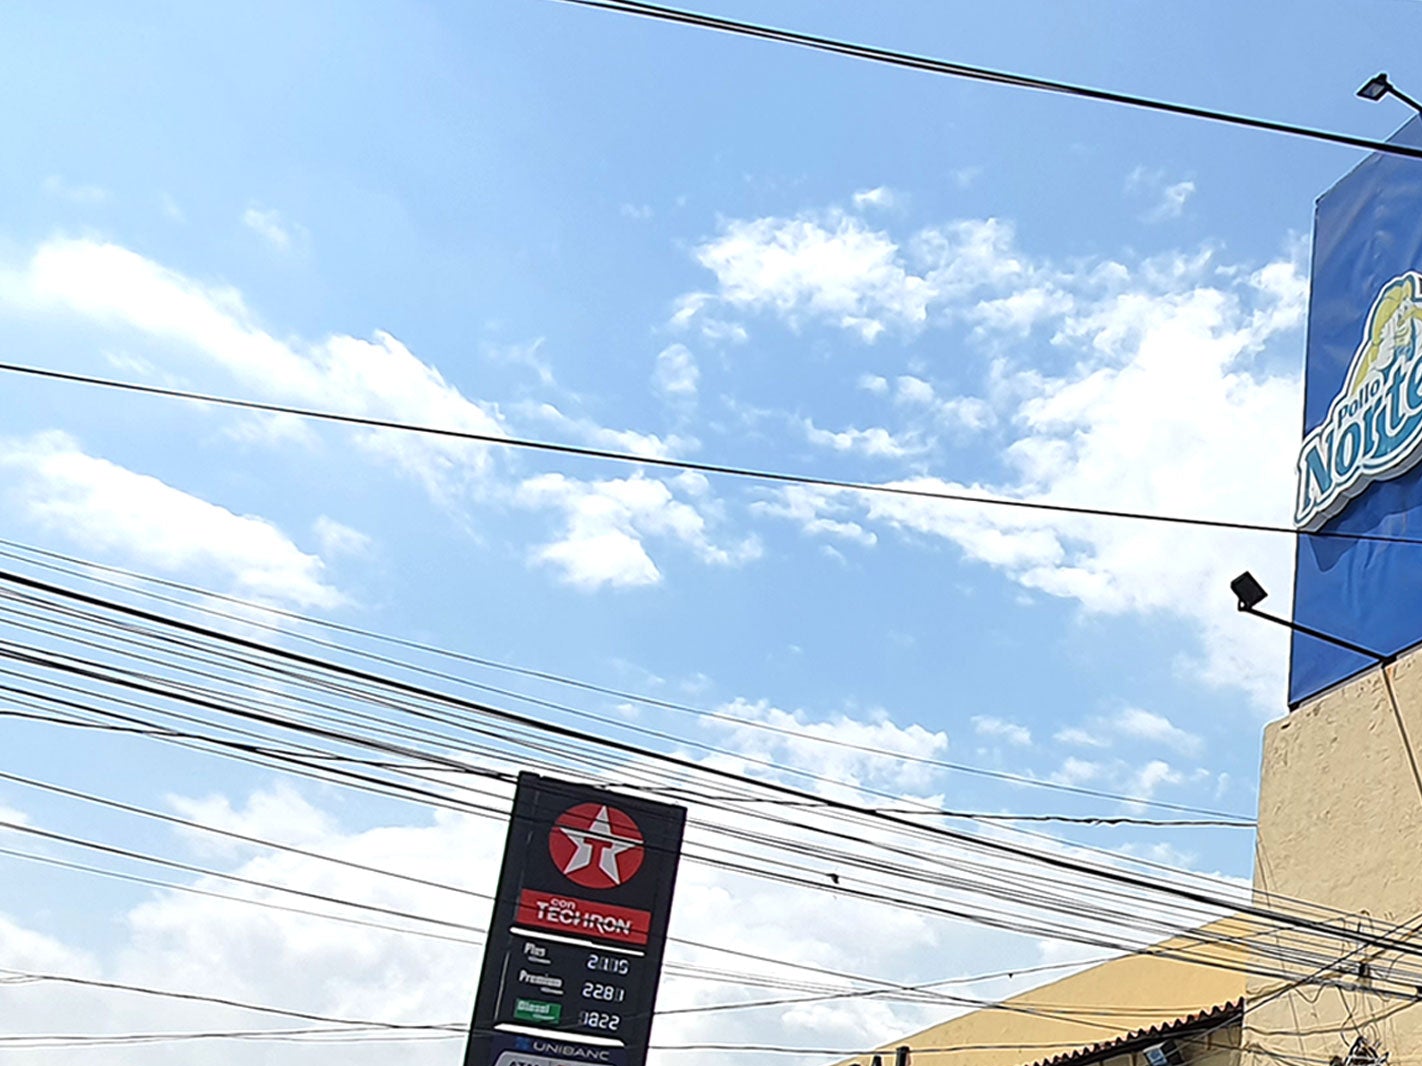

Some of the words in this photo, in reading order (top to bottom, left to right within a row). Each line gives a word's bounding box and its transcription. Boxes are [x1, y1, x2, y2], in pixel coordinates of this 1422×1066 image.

[1338, 379, 1381, 428] Pollo
[550, 898, 576, 910] con
[536, 901, 633, 935] TECHRON
[524, 942, 547, 958] Plus
[582, 982, 625, 1002] 2281
[583, 1011, 620, 1031] 1822
[533, 1040, 610, 1061] UNIBANC
